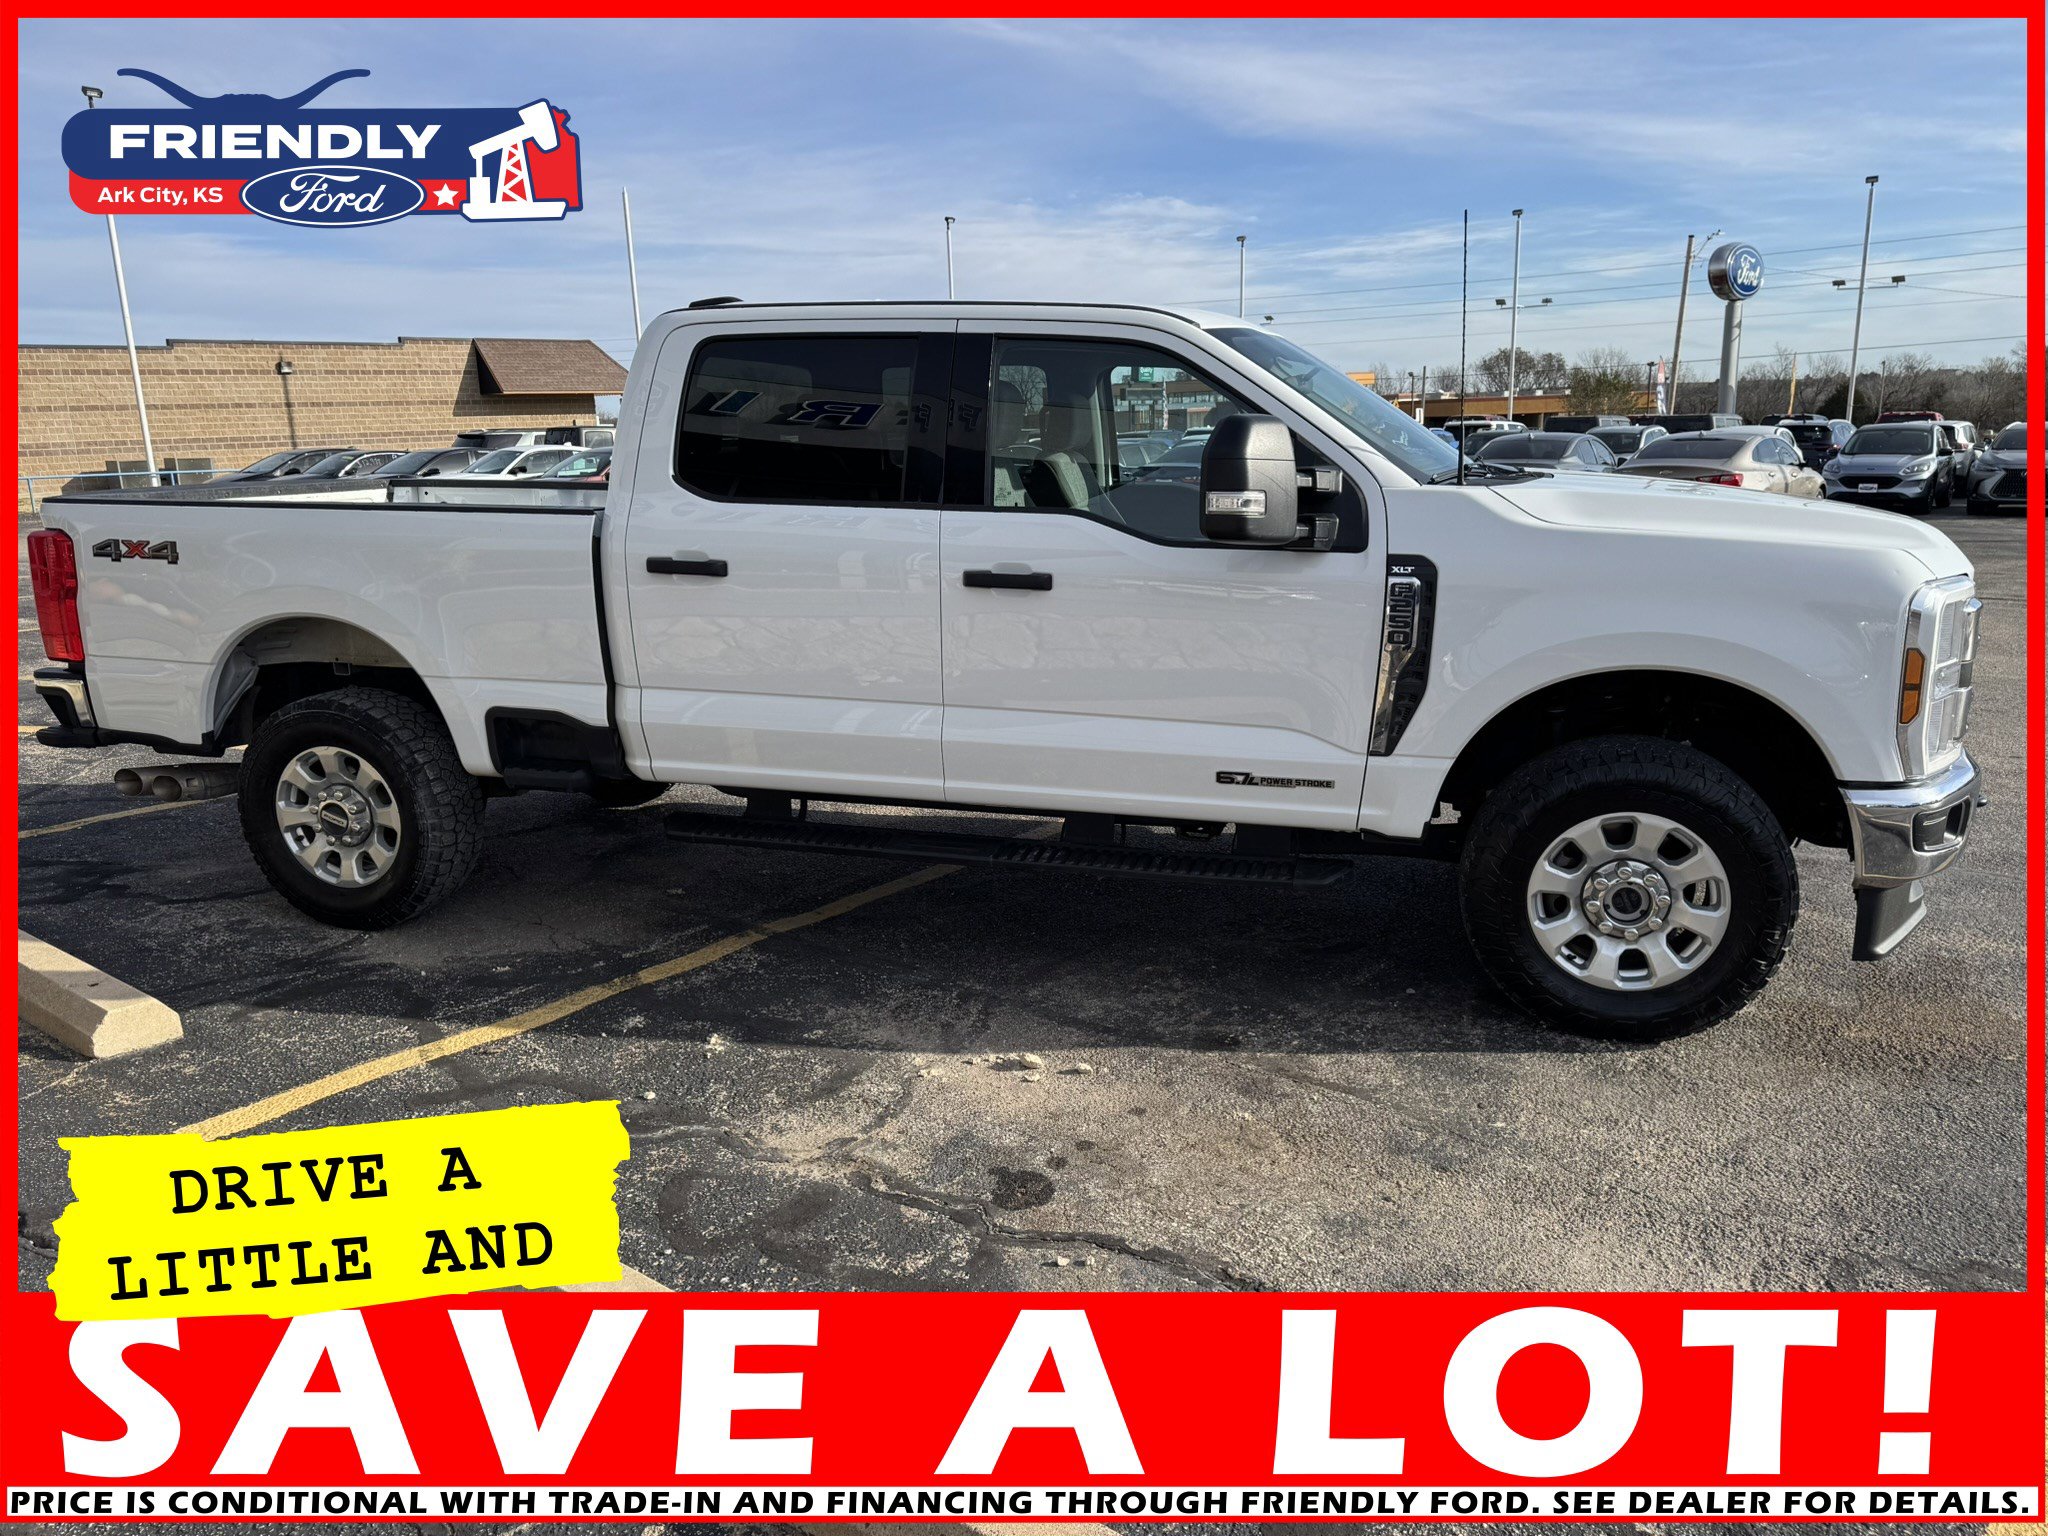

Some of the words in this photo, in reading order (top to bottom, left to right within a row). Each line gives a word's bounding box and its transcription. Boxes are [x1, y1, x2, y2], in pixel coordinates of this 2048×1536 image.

[1737, 253, 1761, 287] Ford
[1391, 566, 1415, 574] XLT
[1216, 771, 1259, 786] 6.7L
[1260, 776, 1293, 786] POWER
[1294, 779, 1332, 788] STROKE
